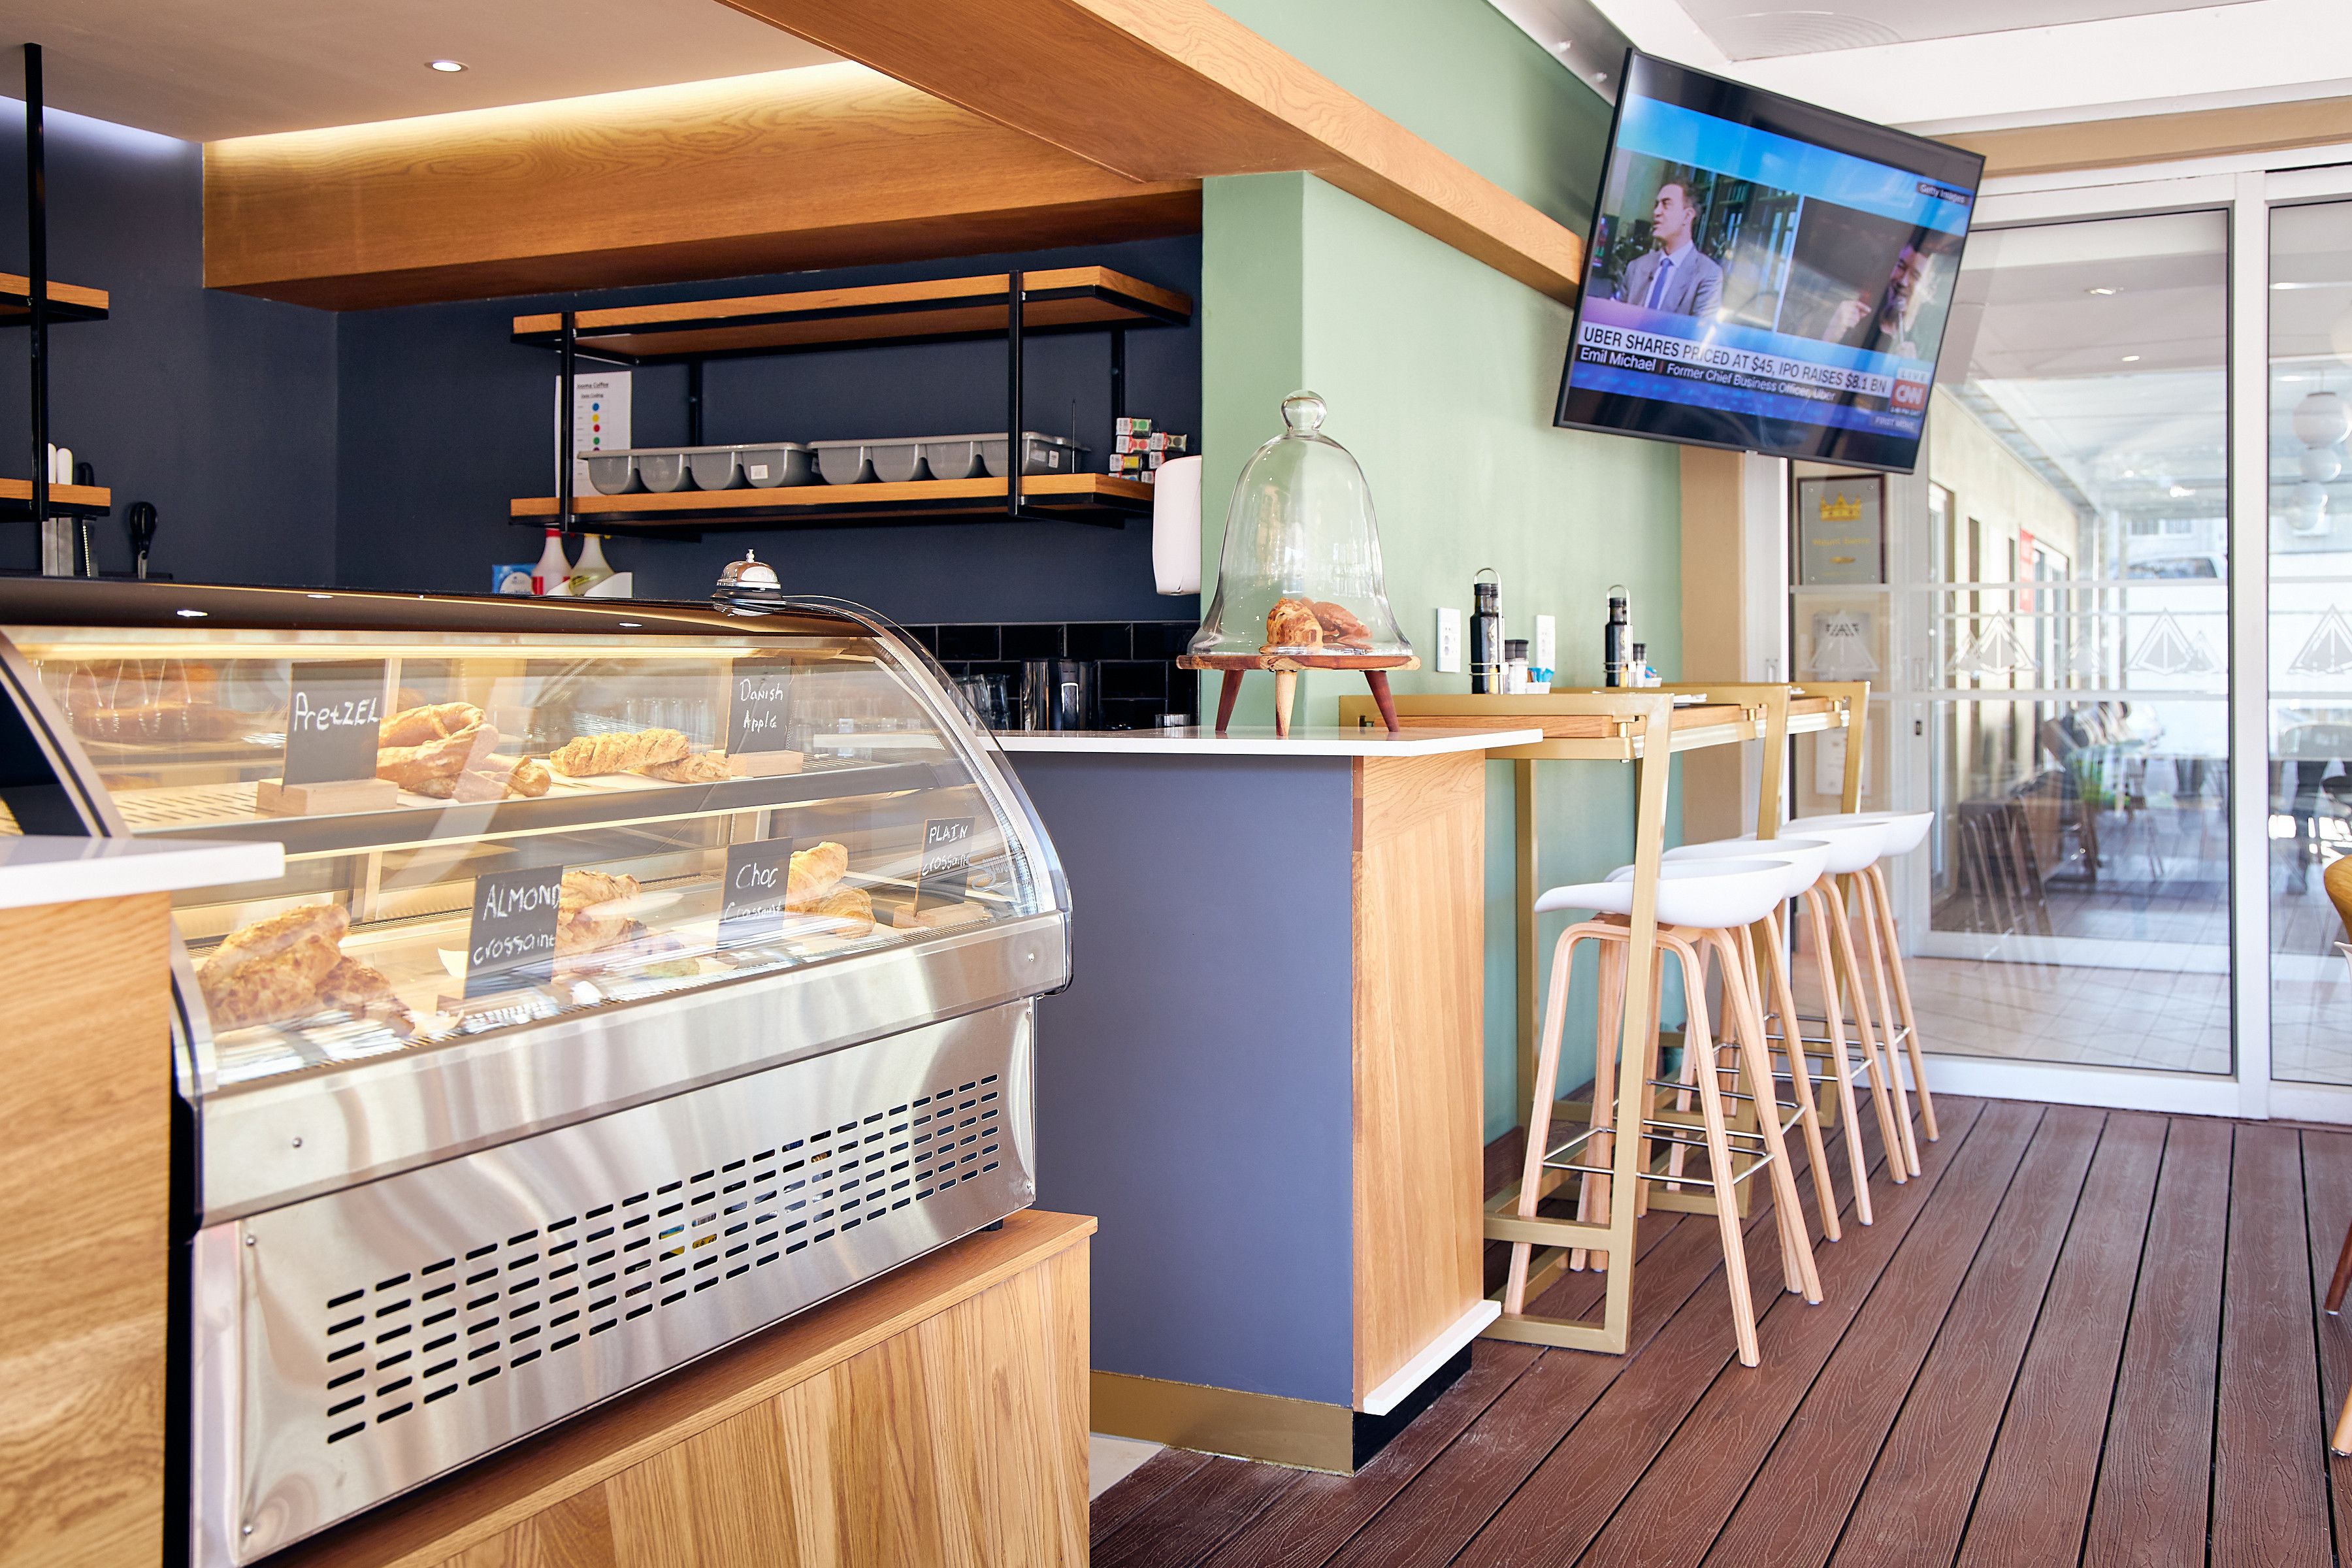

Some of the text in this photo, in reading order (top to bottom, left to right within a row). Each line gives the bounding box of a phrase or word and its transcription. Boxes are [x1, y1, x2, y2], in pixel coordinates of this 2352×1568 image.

[1580, 347, 1607, 363] Emil
[1609, 351, 1657, 372] Michael
[1666, 362, 1704, 380] Former
[1705, 369, 1733, 384] Chief
[1732, 374, 1777, 392] Business
[1813, 388, 1837, 401] Uber
[1584, 326, 1887, 393] UBER SHARES PRICED AT $45, IPO RAISES $8.1 BN
[1895, 384, 1924, 405] CNN
[928, 823, 969, 844] PLAIN
[736, 862, 779, 889] Choc
[482, 883, 561, 921] ALMOND
